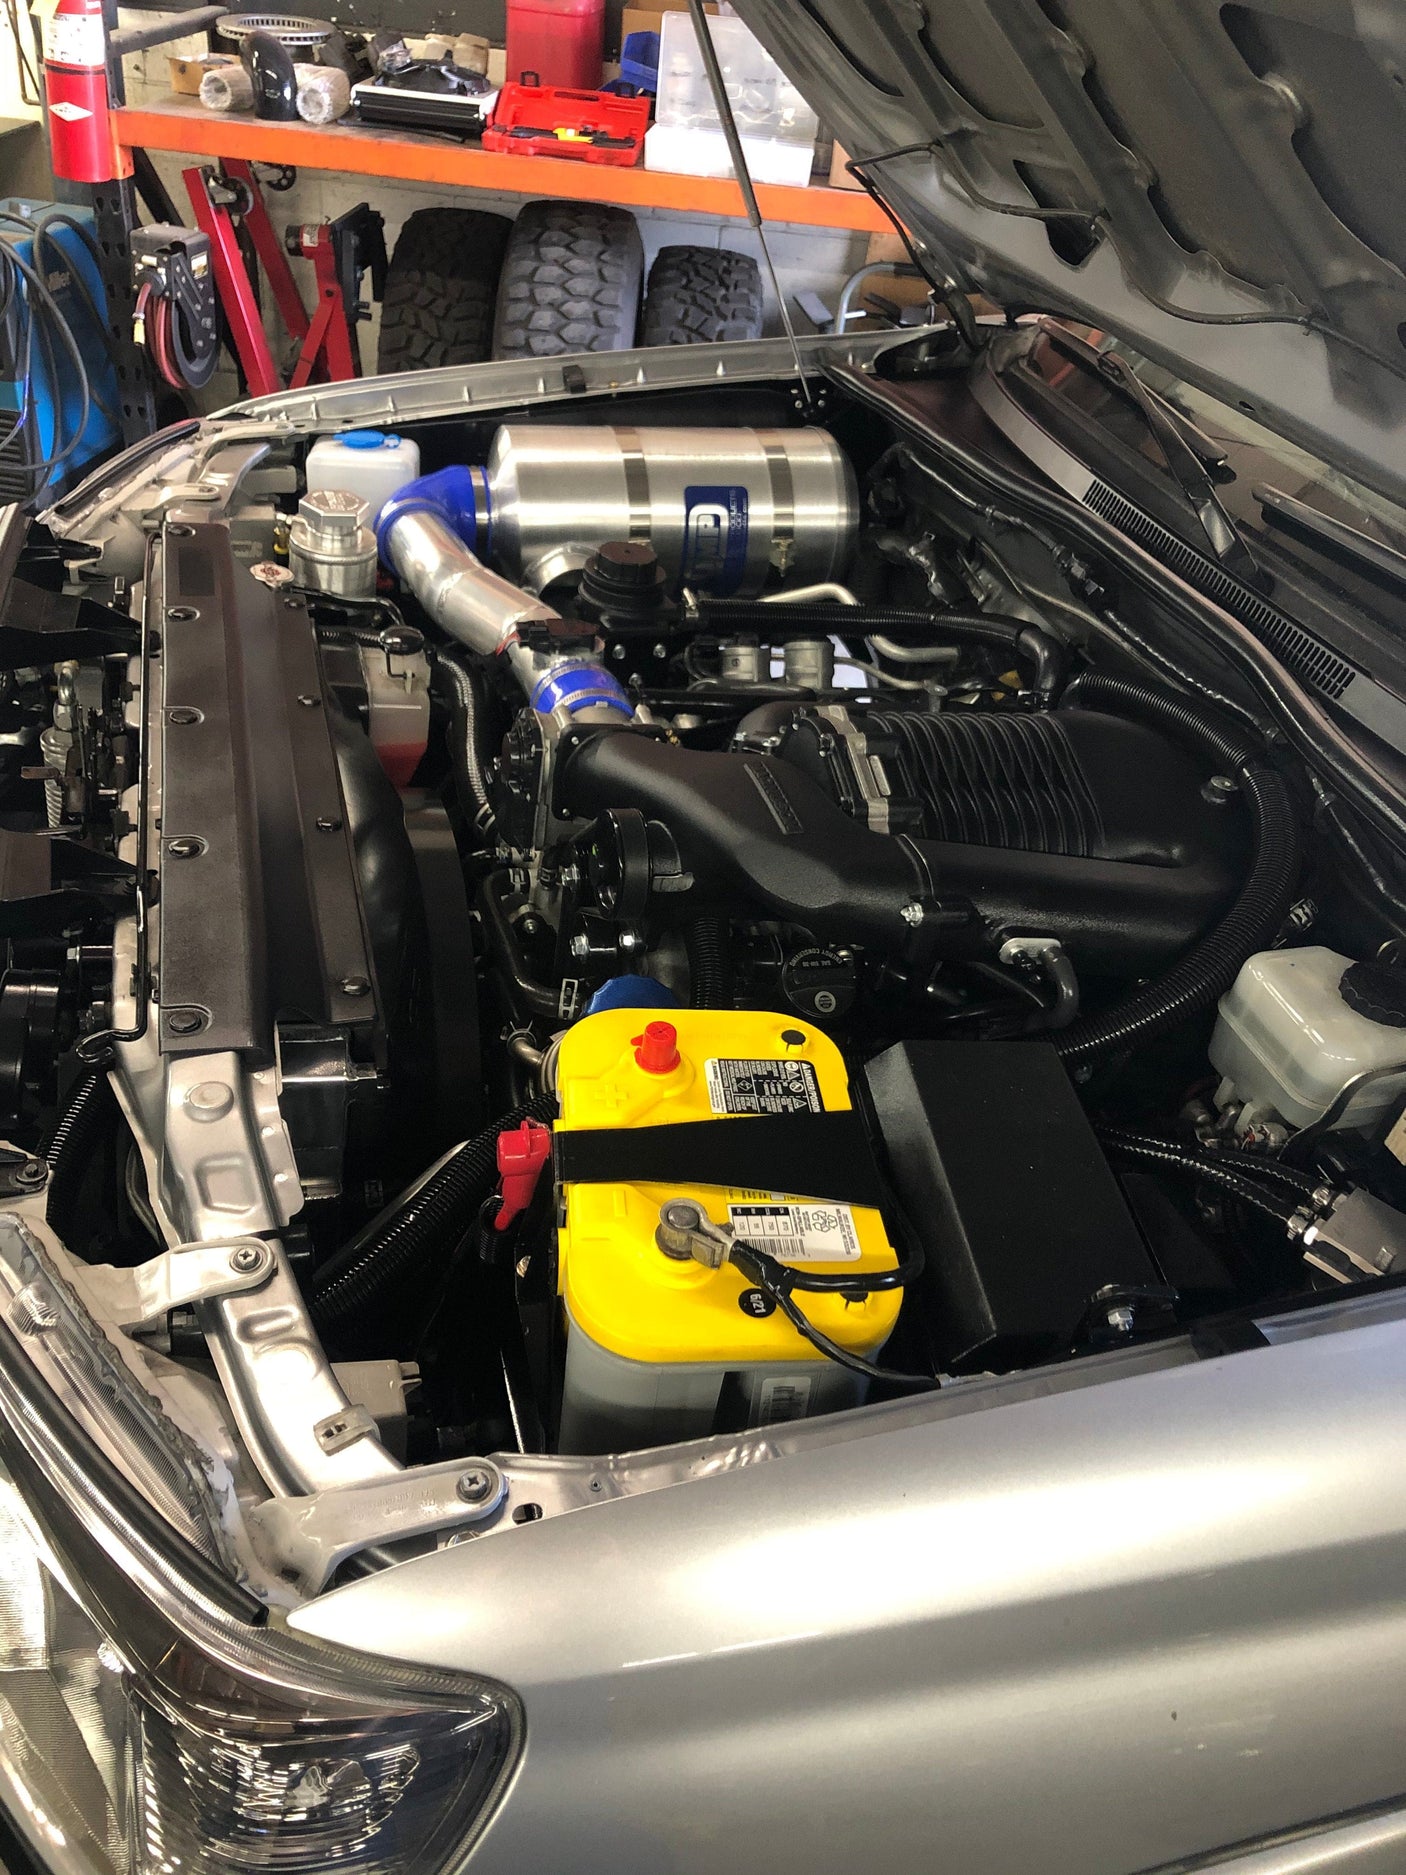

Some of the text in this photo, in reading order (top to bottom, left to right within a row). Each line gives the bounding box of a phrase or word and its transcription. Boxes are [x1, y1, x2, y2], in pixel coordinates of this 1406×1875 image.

[789, 948, 820, 967] CONSERVING
[804, 1069, 821, 1112] DANGER/POISON
[750, 1293, 766, 1313] 6/21
